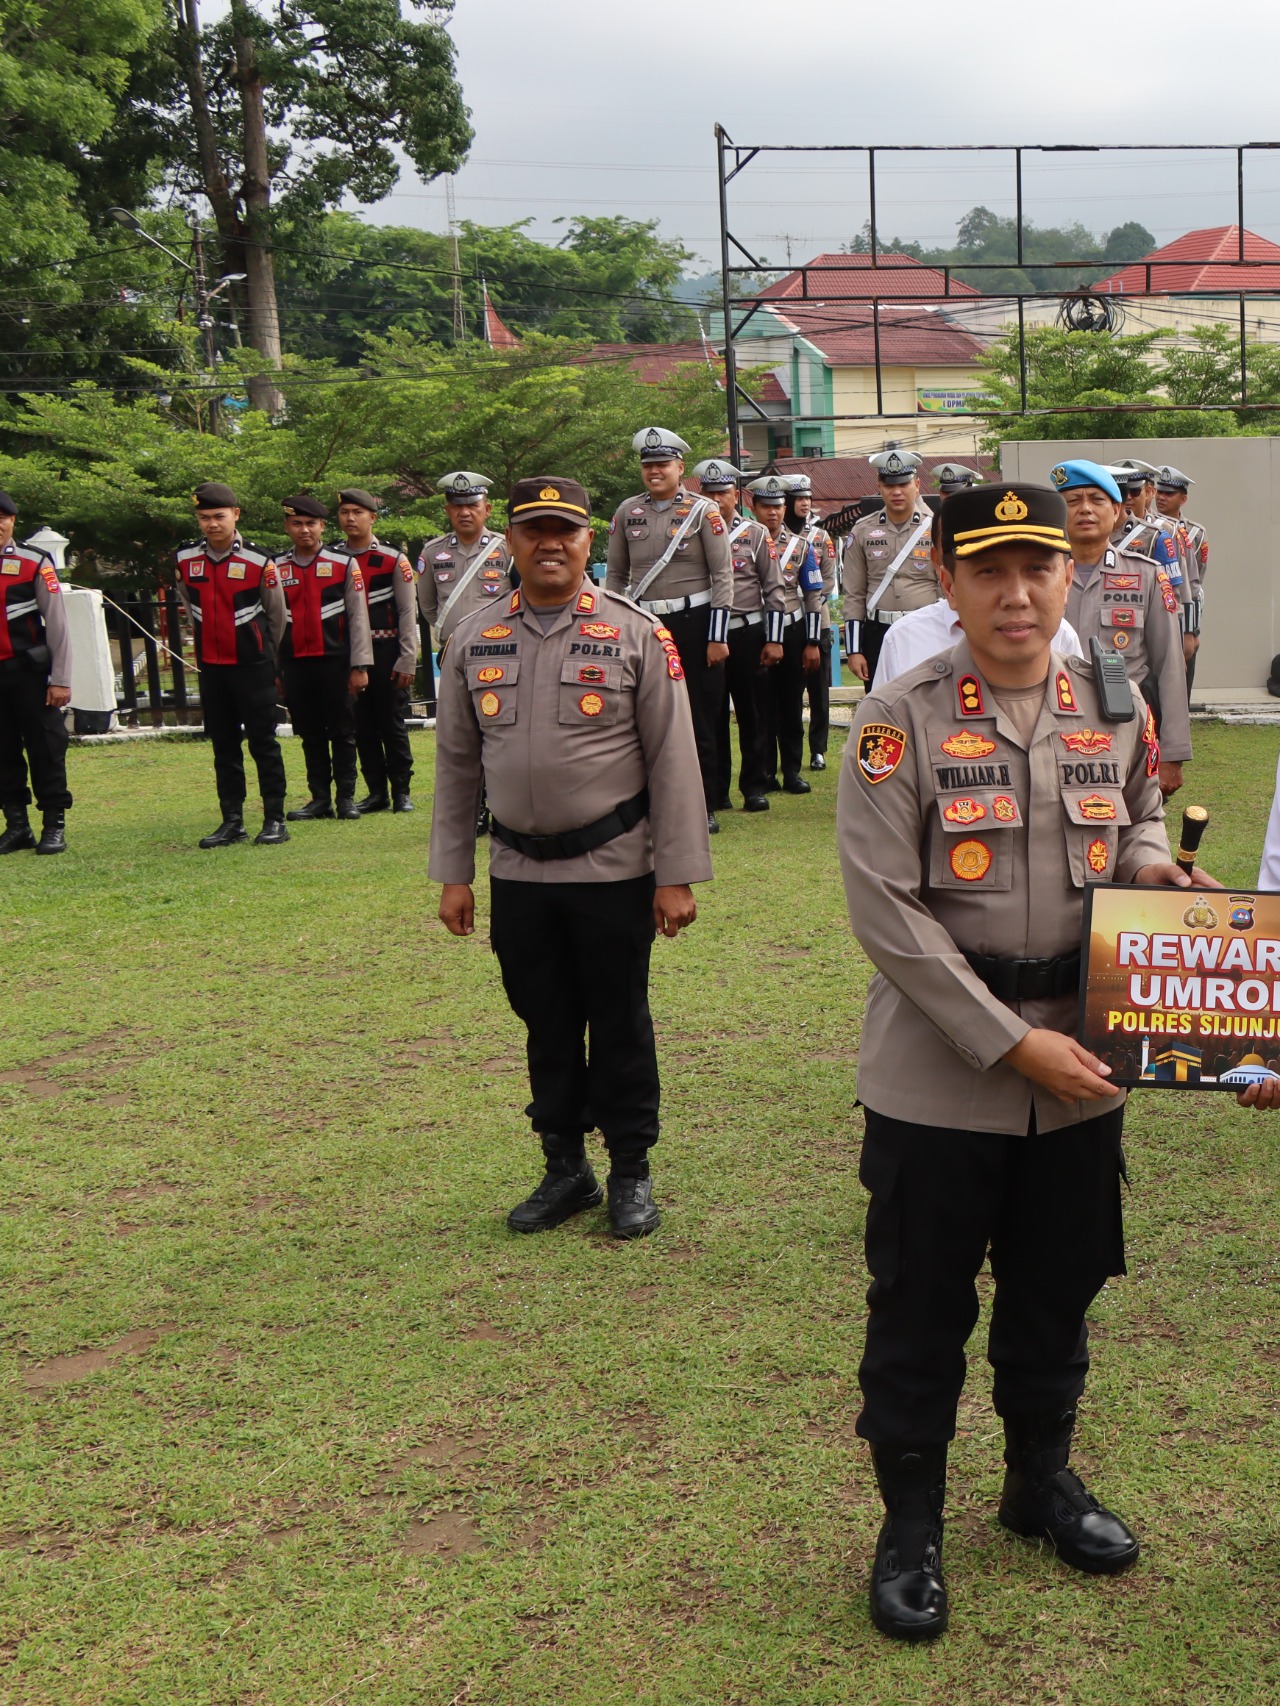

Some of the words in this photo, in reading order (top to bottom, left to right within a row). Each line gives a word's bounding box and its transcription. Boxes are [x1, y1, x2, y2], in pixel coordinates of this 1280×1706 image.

[1103, 593, 1144, 604] POLRI
[569, 643, 621, 657] POLRI
[1062, 762, 1120, 785] POLRI
[1107, 1010, 1192, 1034] POLRES
